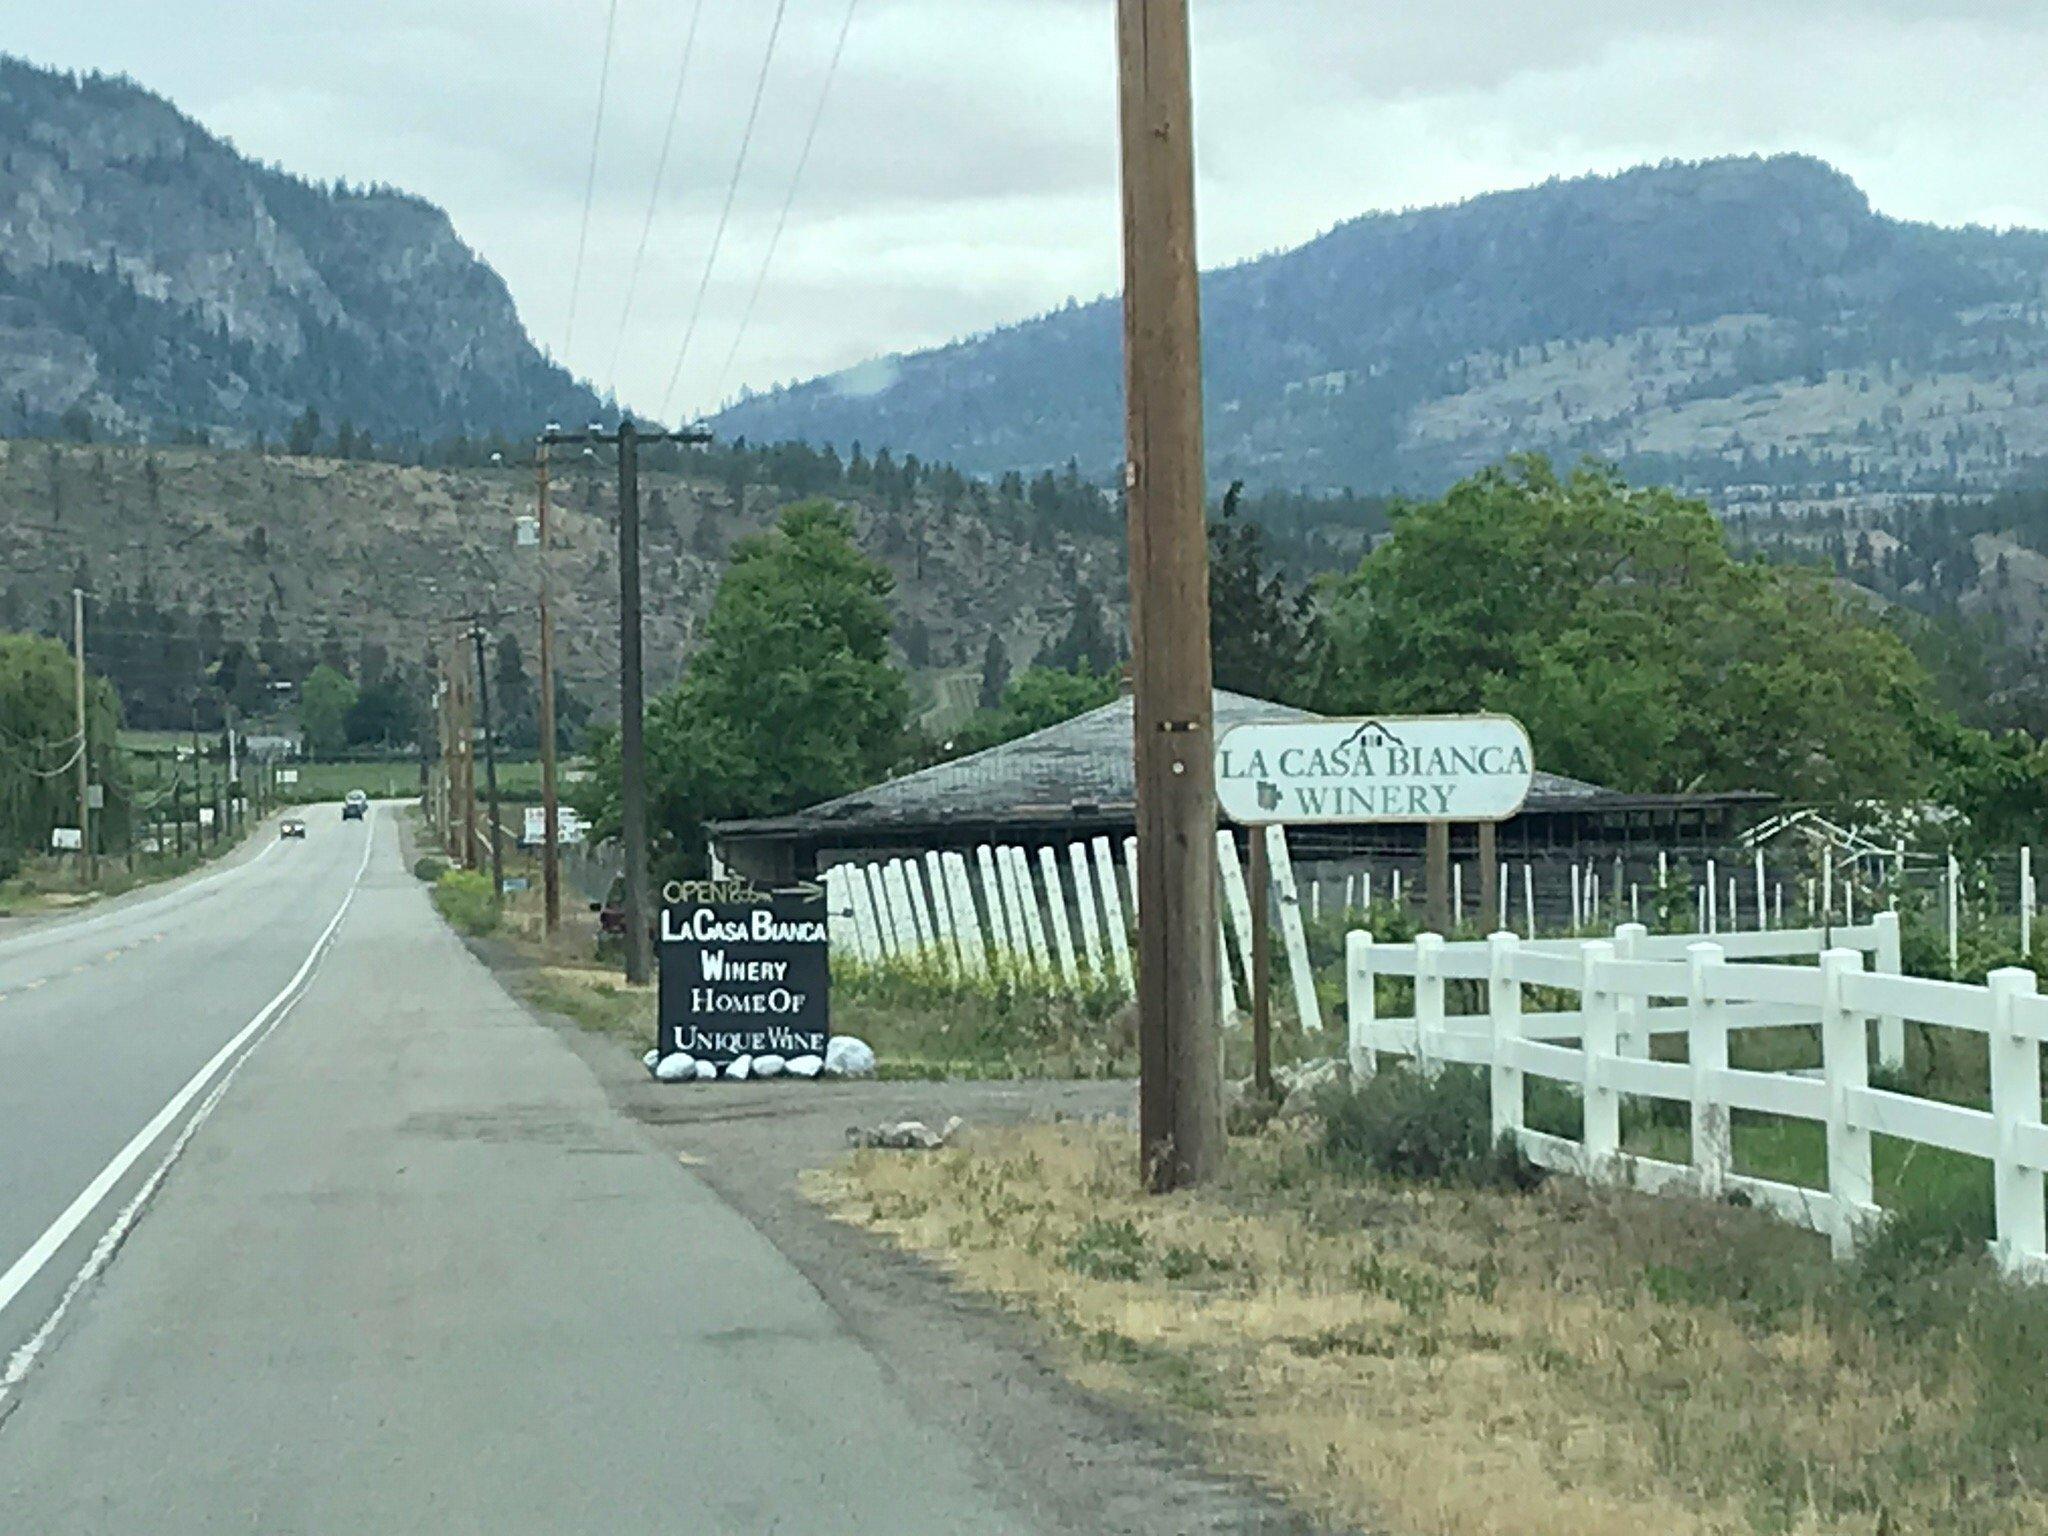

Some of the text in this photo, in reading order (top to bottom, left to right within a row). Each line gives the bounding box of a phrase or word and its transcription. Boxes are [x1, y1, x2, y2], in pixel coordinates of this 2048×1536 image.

[1221, 746, 1528, 778] LA CASA BIANCA
[1294, 785, 1457, 816] WINERY
